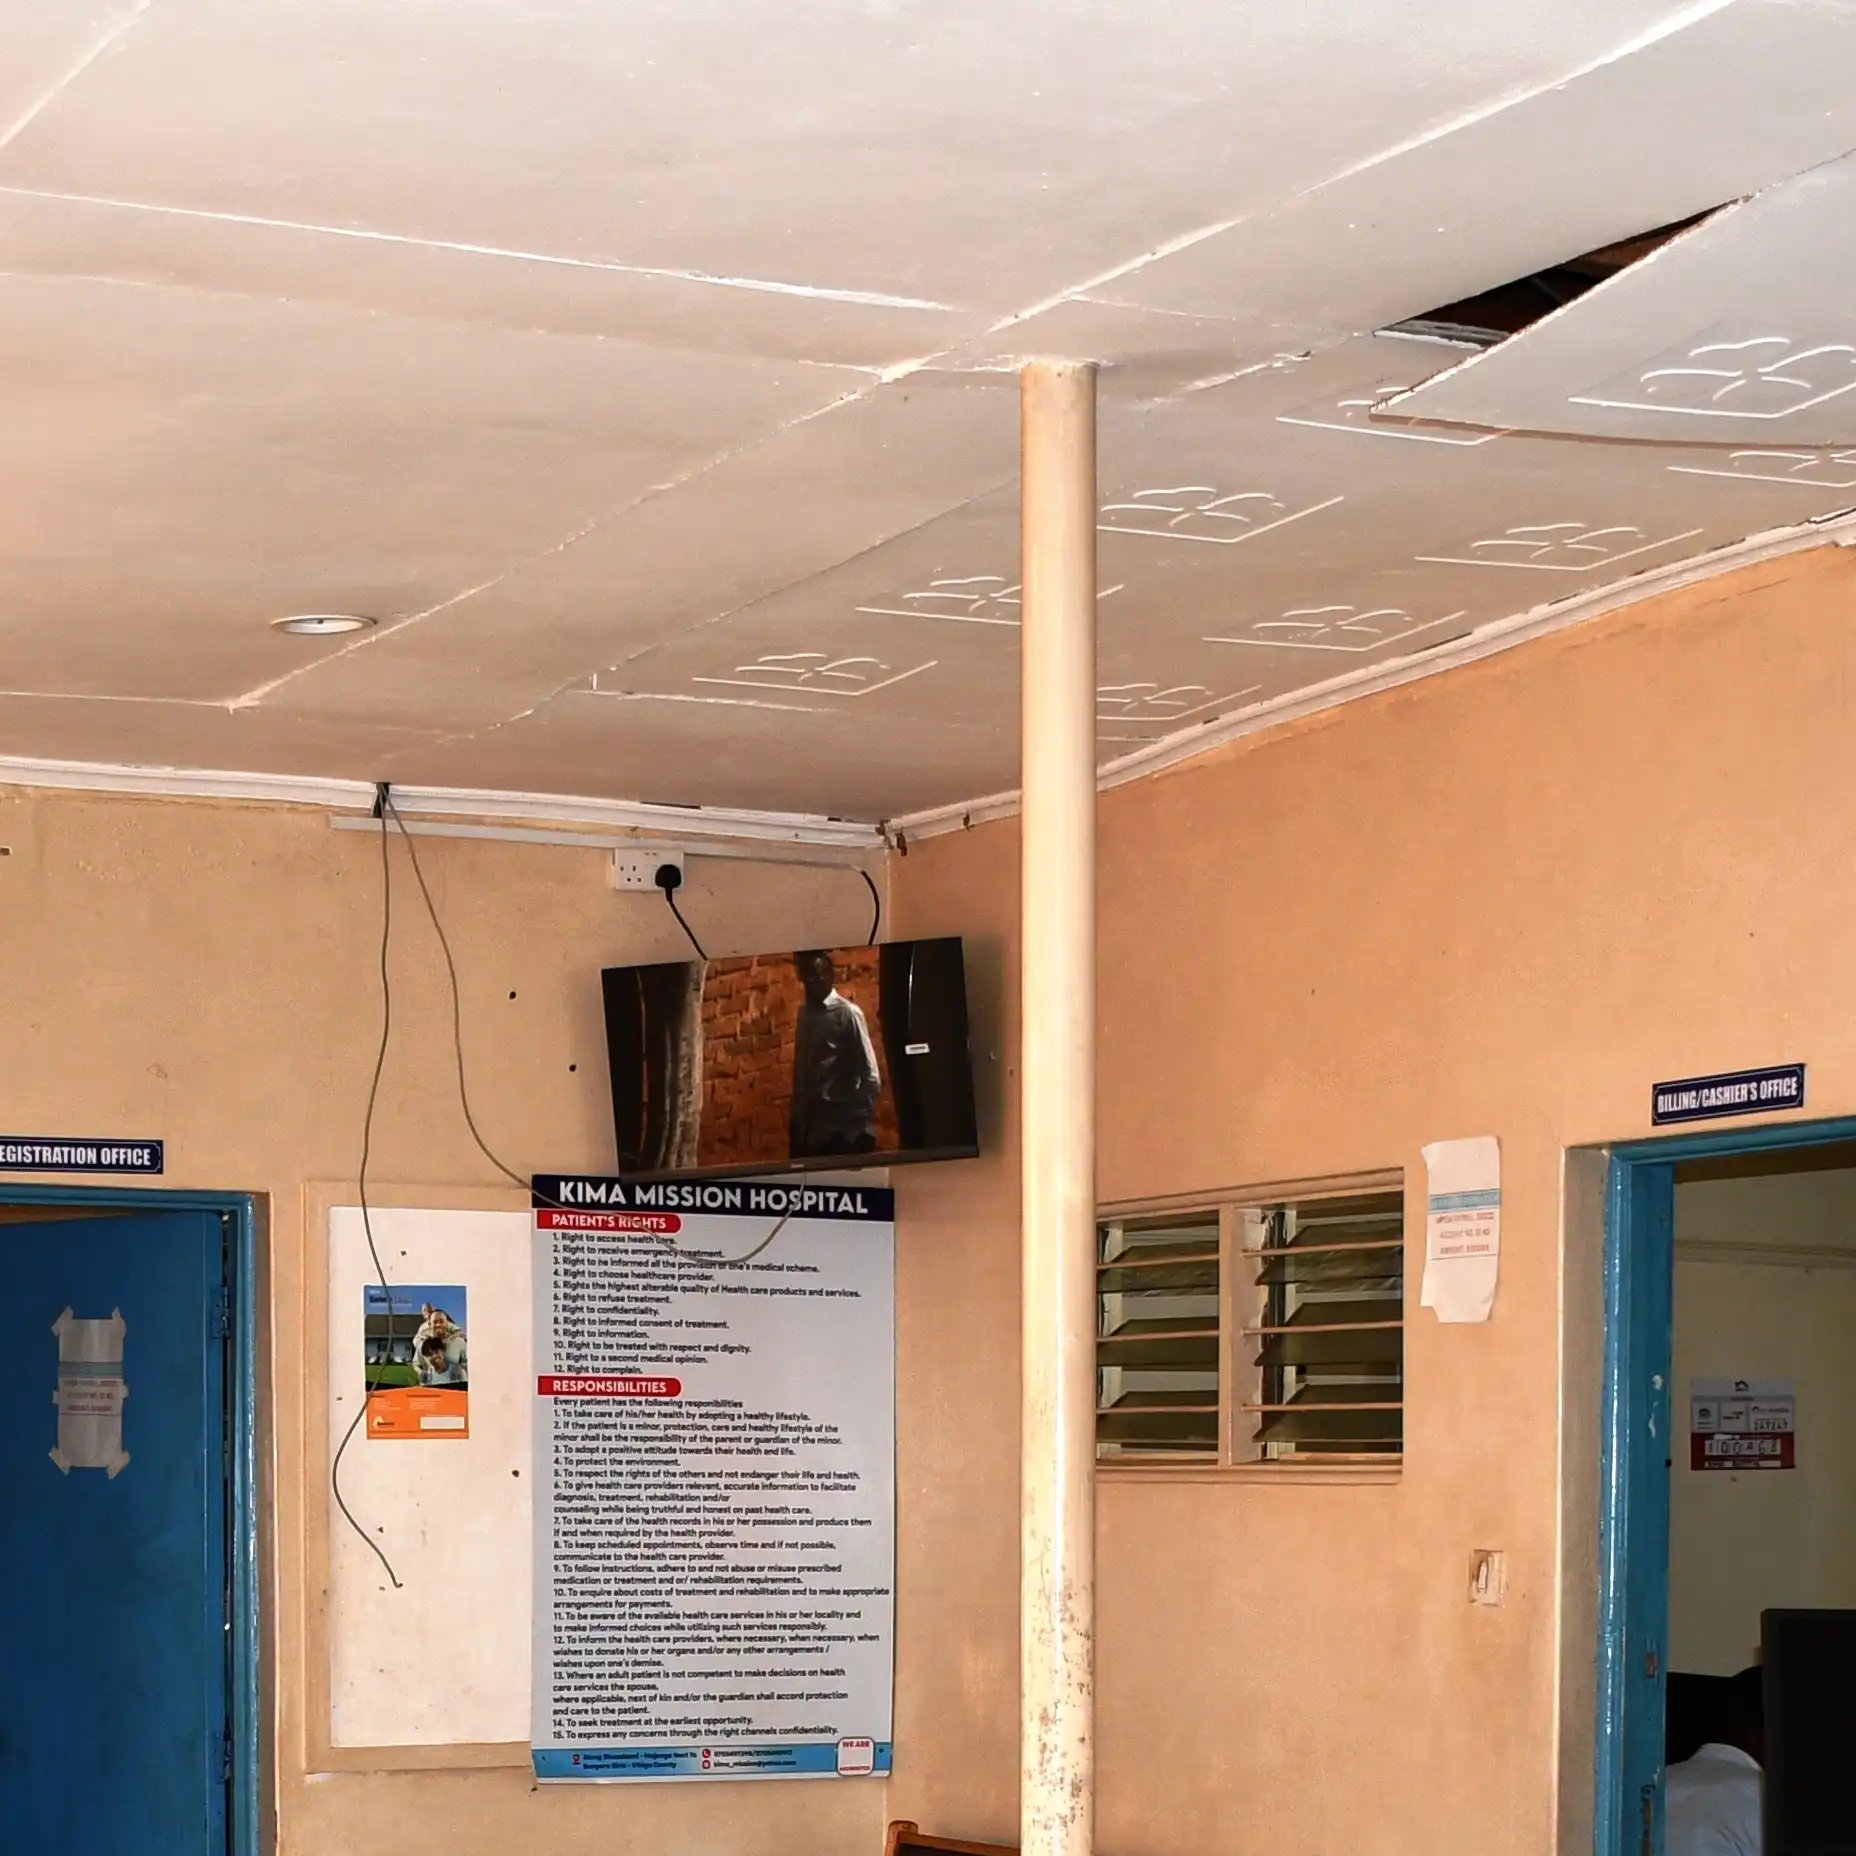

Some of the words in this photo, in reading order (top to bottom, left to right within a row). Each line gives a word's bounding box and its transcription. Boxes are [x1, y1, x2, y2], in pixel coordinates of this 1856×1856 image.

[1658, 1082, 1758, 1113] BILLING/CASHIER'S
[1760, 1077, 1797, 1101] OFFICE
[101, 1148, 151, 1165] OFFICE
[559, 1181, 626, 1205] KIMA
[635, 1185, 741, 1208] MISSION
[750, 1188, 868, 1214] HOSPITAL
[552, 1214, 615, 1227] PATIENT'S
[619, 1217, 666, 1229] RIGHTS
[562, 1304, 584, 1315] Right
[597, 1306, 659, 1316] confidentiality.
[553, 1341, 566, 1349] 10.
[568, 1342, 590, 1352] Right
[593, 1342, 601, 1350] to
[603, 1342, 614, 1350] be
[616, 1343, 647, 1351] treated
[649, 1343, 667, 1351] with
[669, 1344, 701, 1353] respect
[703, 1344, 719, 1352] and
[721, 1344, 751, 1354] dignity.
[553, 1365, 565, 1373] 12.
[567, 1365, 589, 1374] Right
[602, 1366, 643, 1375] complain.
[553, 1380, 667, 1393] RESPONSIBILITIES
[576, 1458, 607, 1467] protect
[609, 1458, 623, 1466] the
[625, 1458, 681, 1466] environment.
